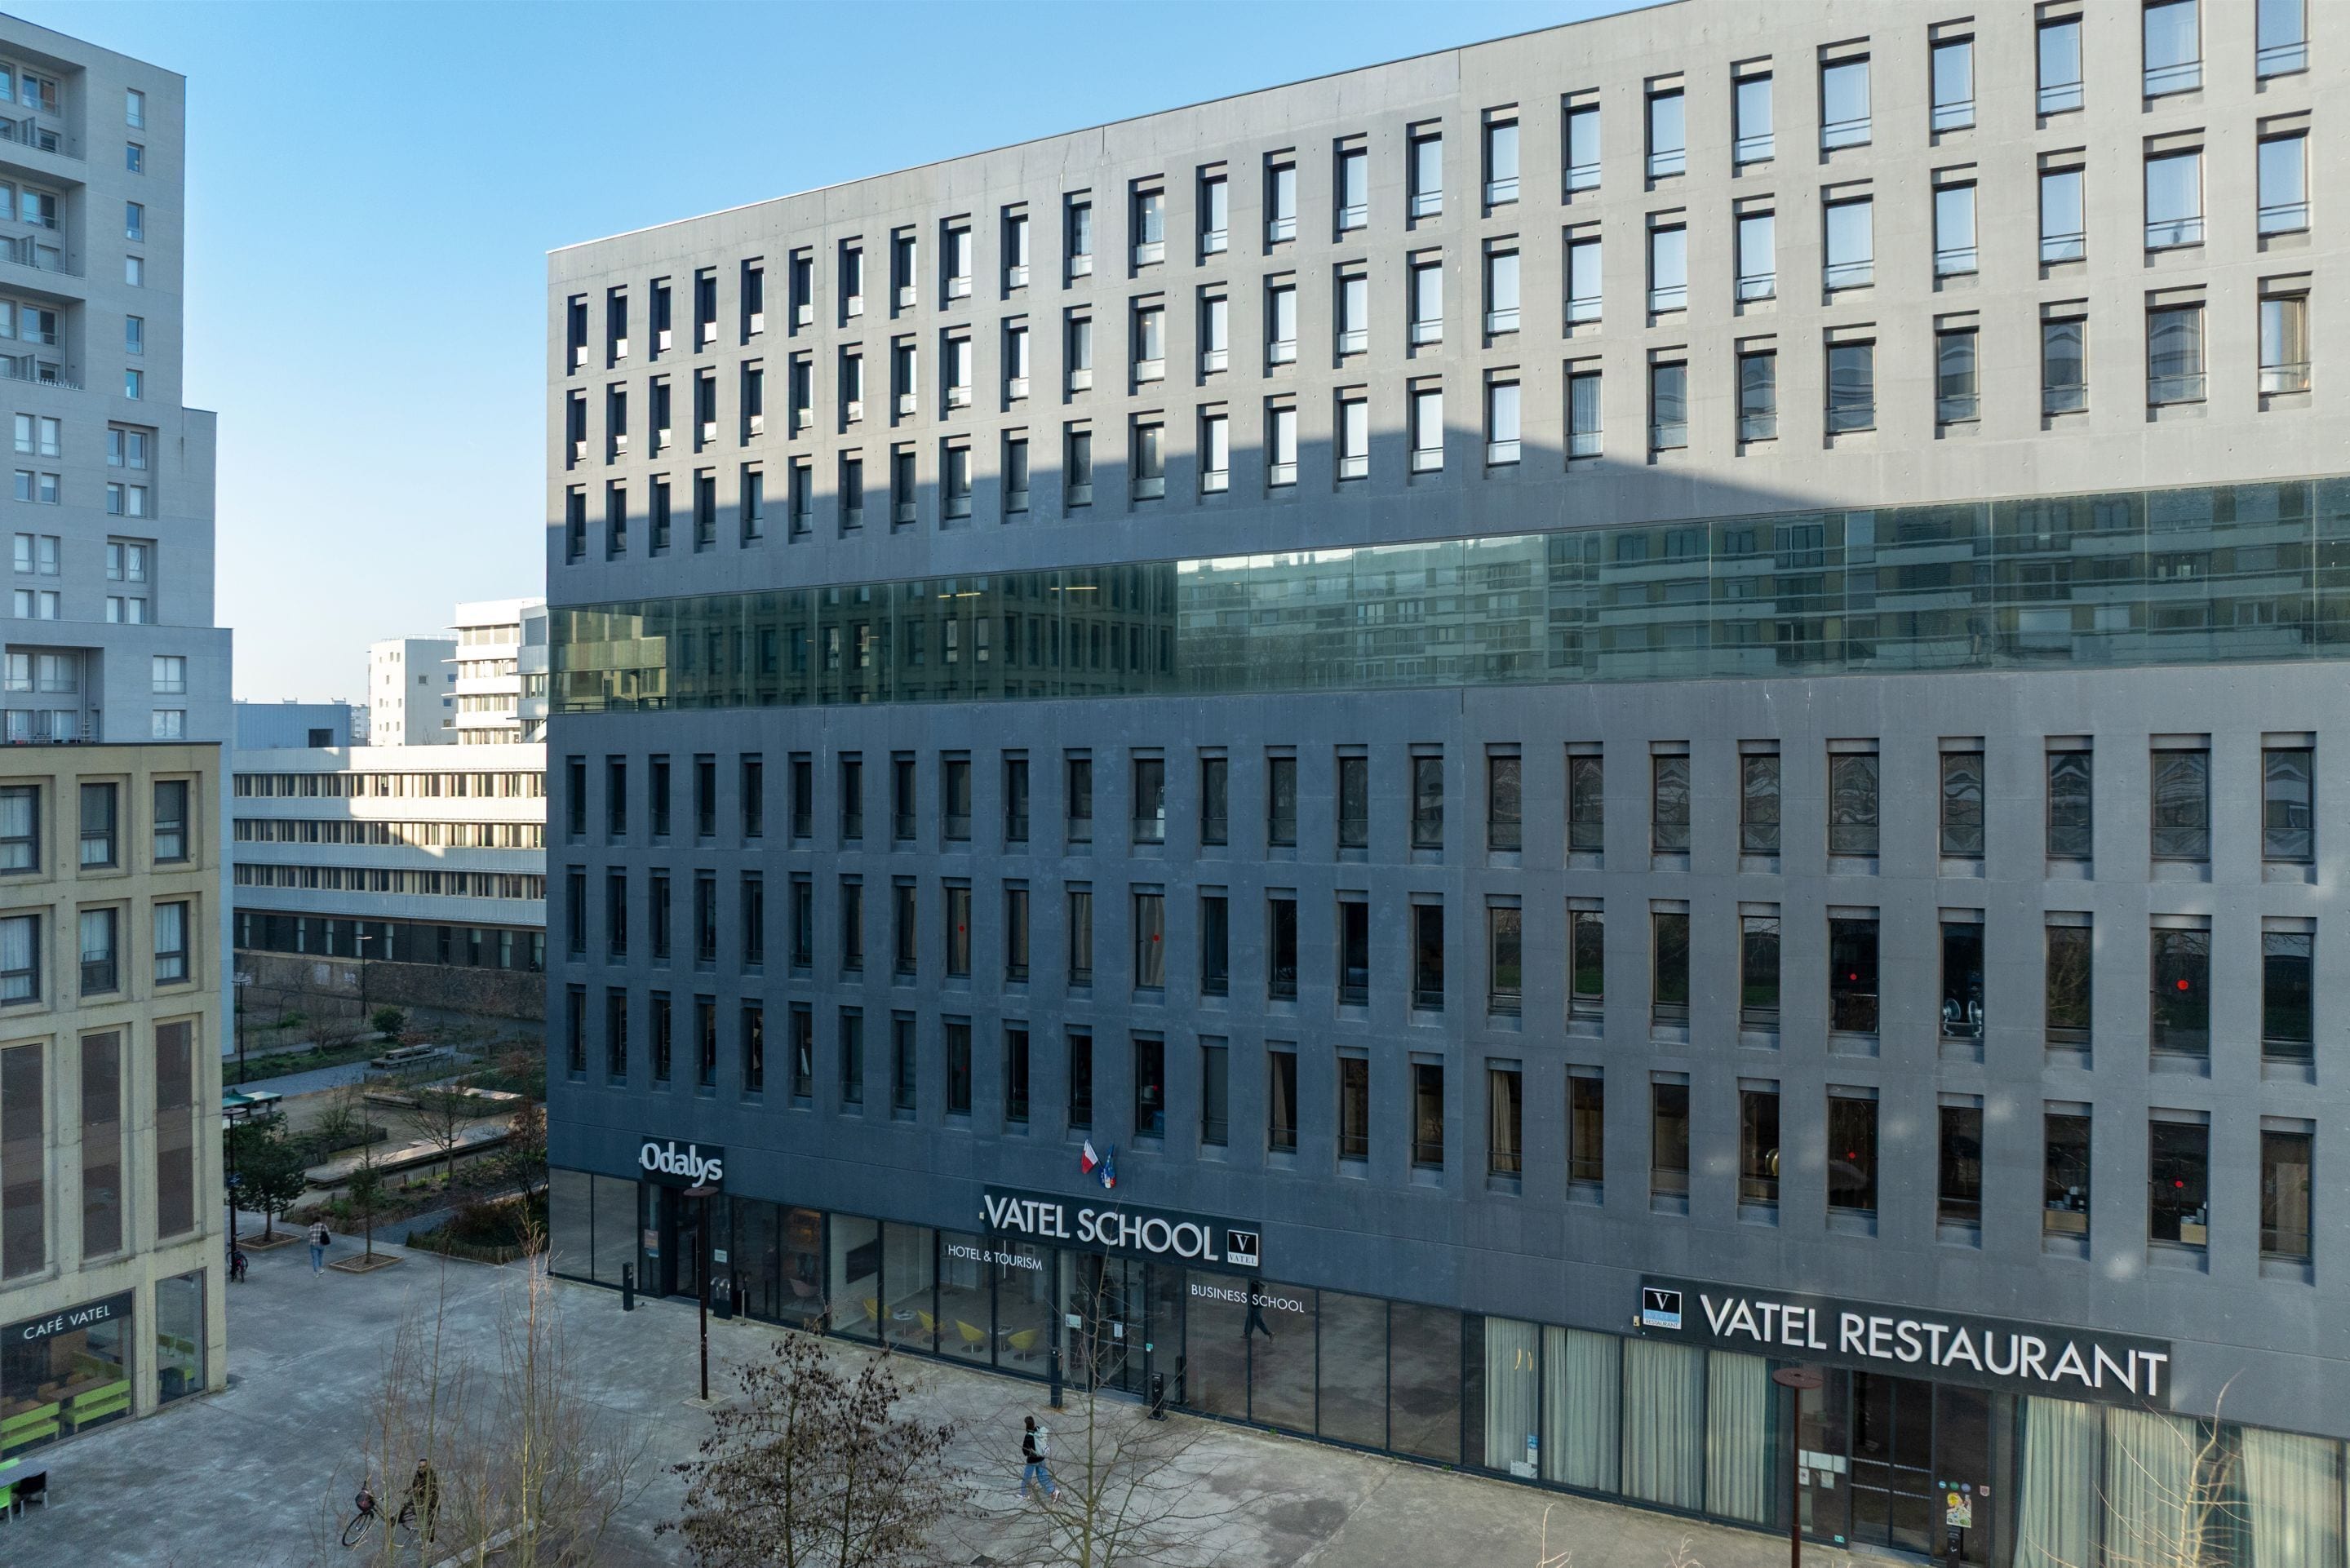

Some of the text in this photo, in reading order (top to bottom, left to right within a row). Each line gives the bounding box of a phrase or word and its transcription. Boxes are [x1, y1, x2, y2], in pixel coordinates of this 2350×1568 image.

[641, 1141, 723, 1188] Odalys
[984, 1194, 1218, 1261] VATEL SCHOOL
[1235, 1234, 1250, 1251] V
[948, 1244, 1043, 1271] HOTEL & TOURISM
[1229, 1252, 1257, 1265] VATEL
[1191, 1284, 1305, 1313] BUSINESS SCHOOL
[1653, 1292, 1670, 1310] V
[24, 1305, 111, 1340] CAFÉ VATEL
[1700, 1294, 2168, 1396] VATEL RESTAURANT
